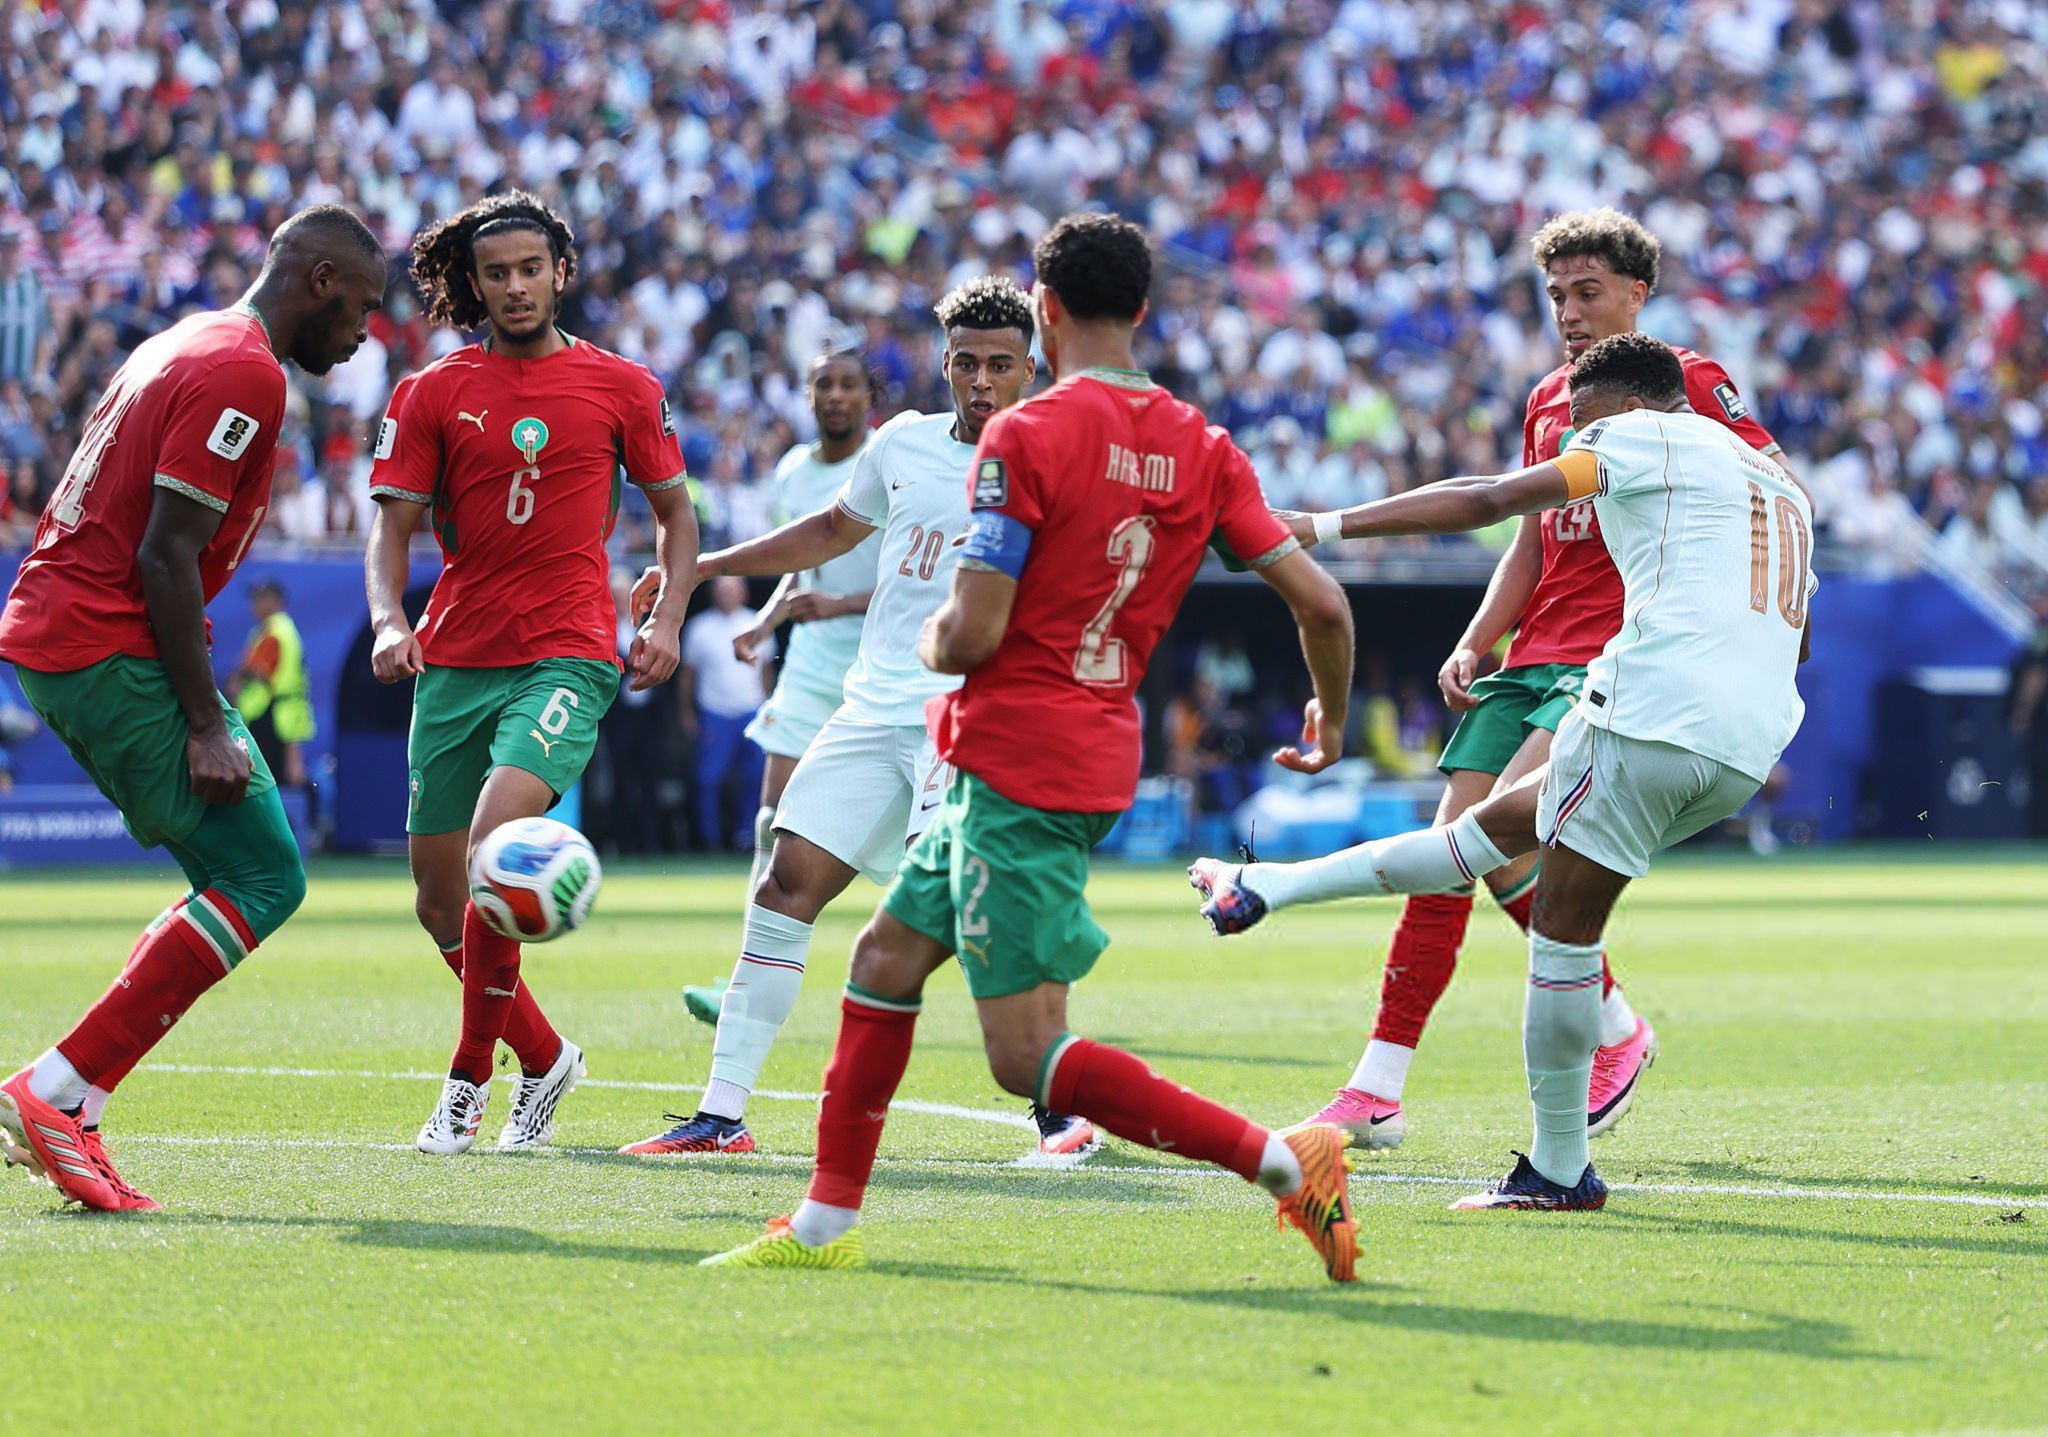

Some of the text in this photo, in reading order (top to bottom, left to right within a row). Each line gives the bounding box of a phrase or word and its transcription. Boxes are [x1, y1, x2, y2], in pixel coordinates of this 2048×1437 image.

[507, 465, 540, 525] 6
[898, 525, 945, 581] 20
[1747, 480, 1809, 630] 10
[1073, 514, 1158, 688] 2
[538, 687, 579, 736] 6
[962, 855, 990, 937] 2
